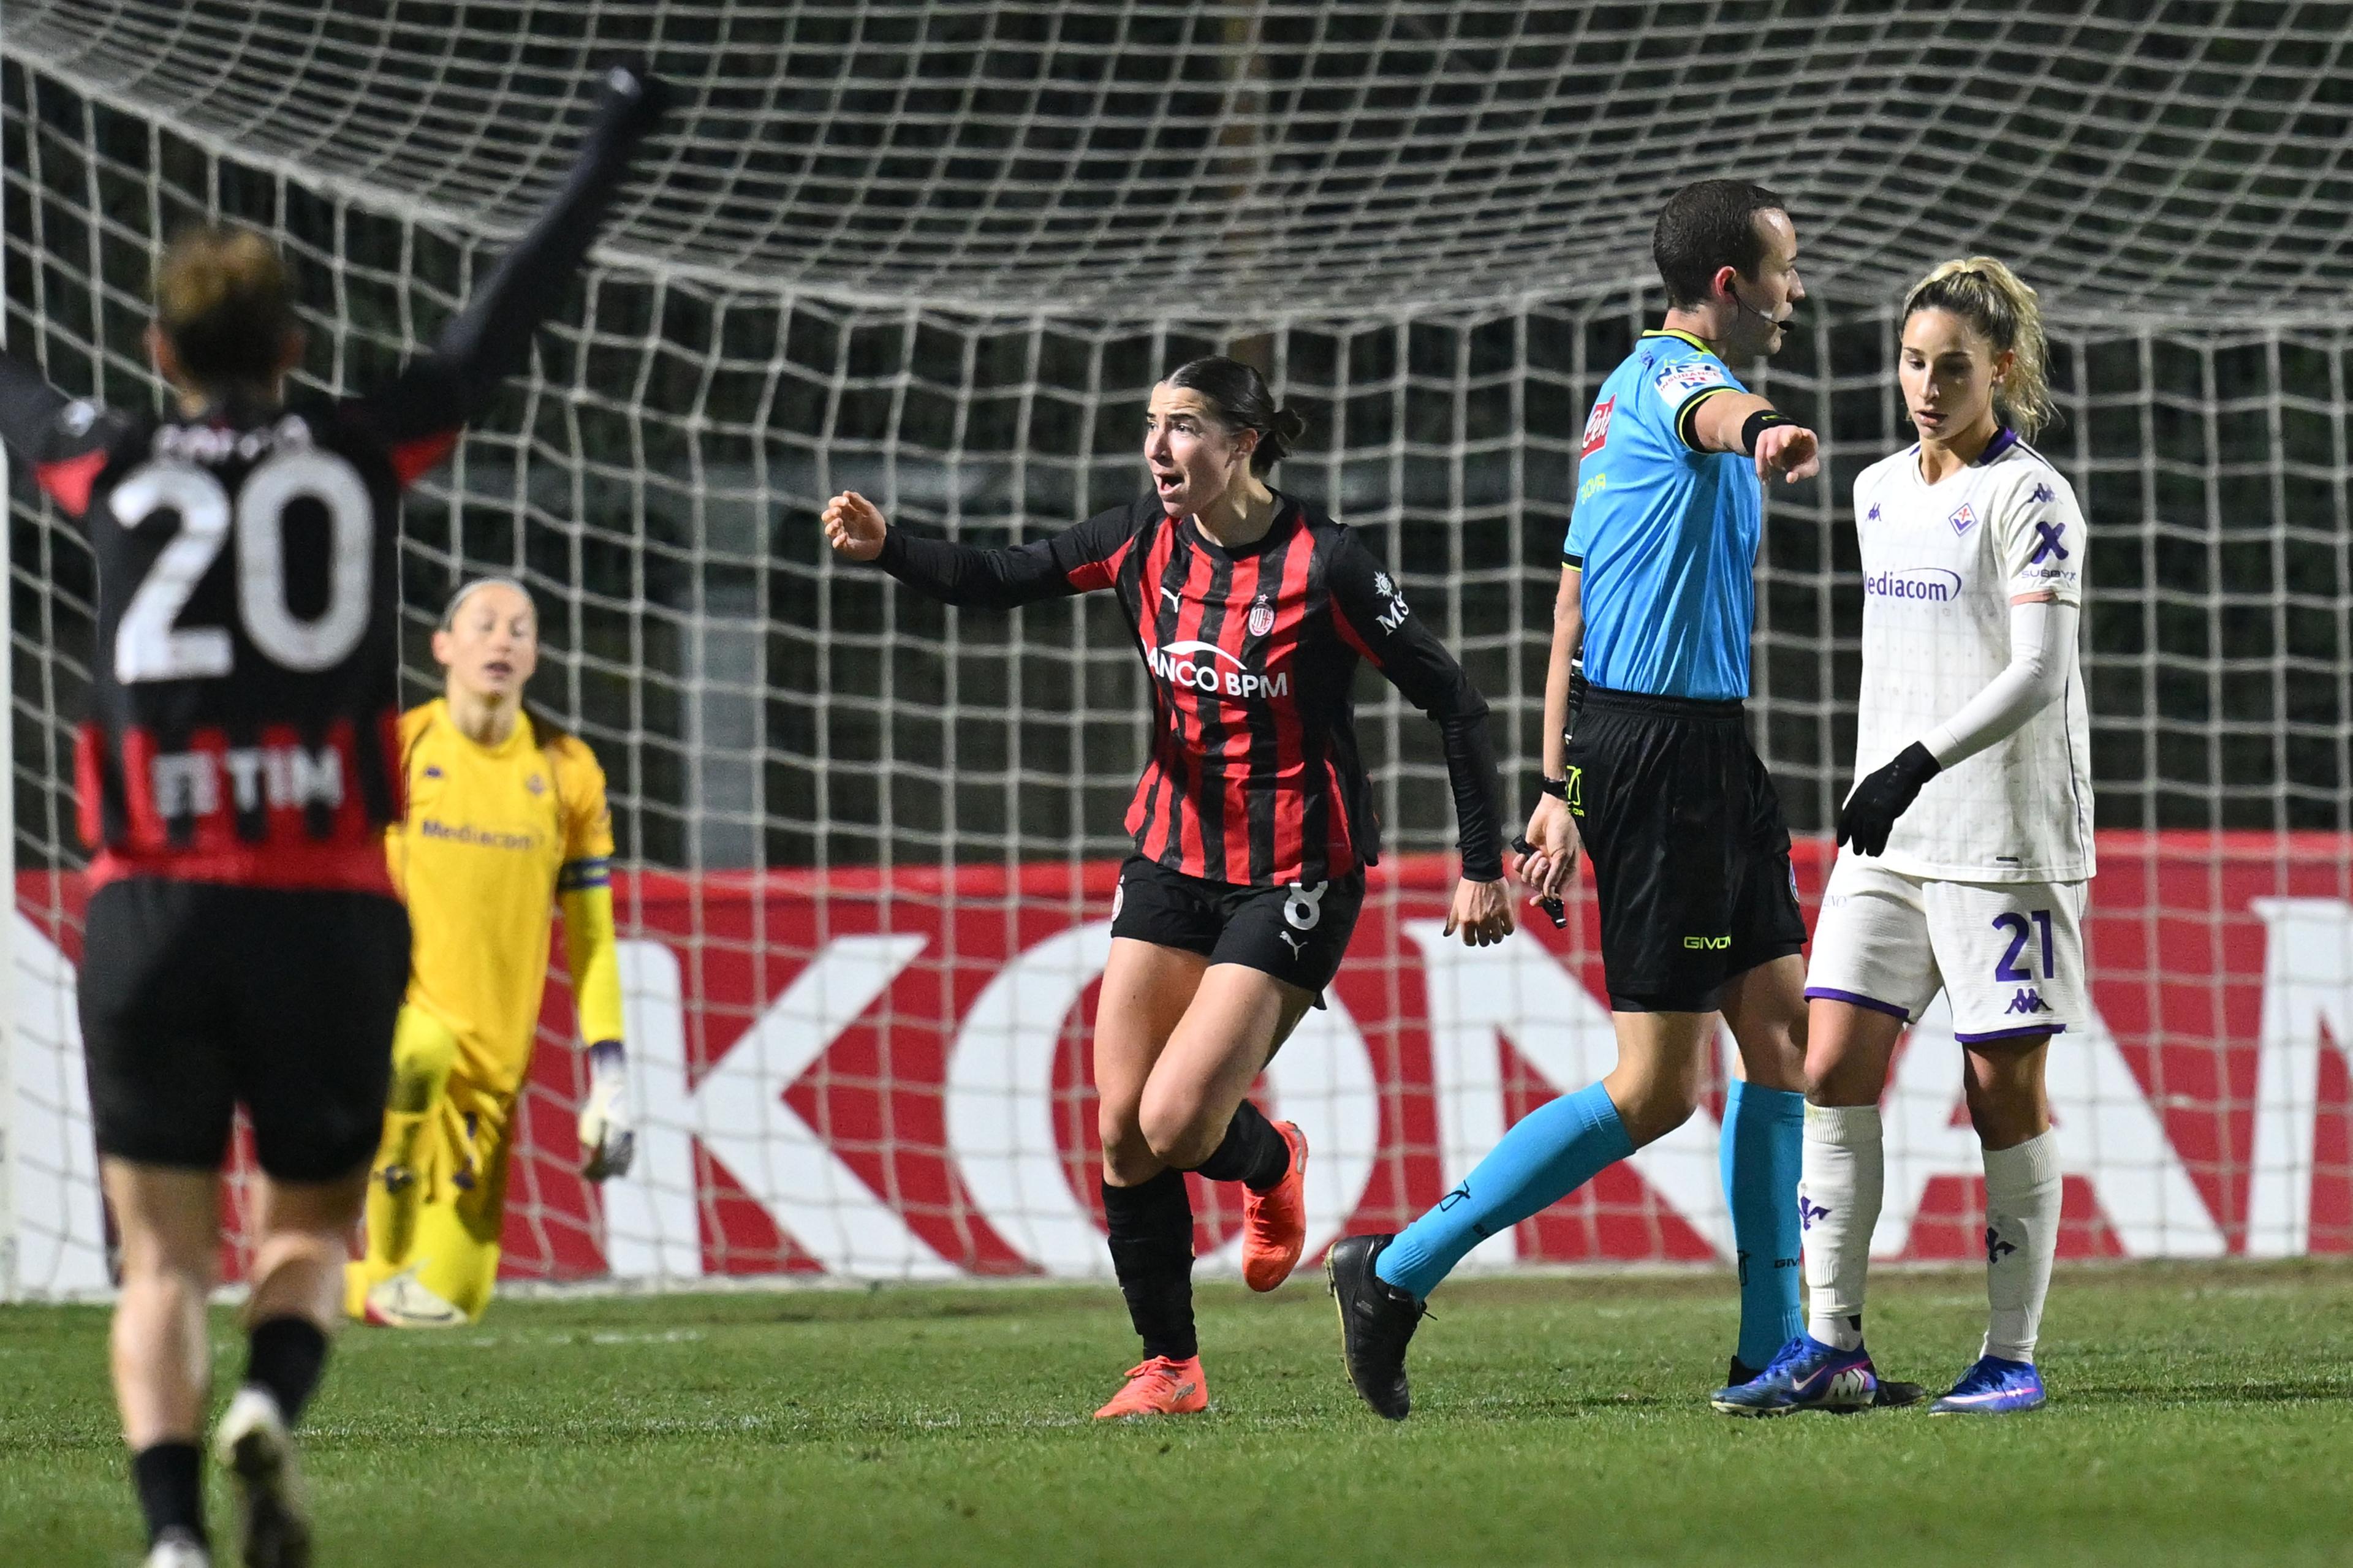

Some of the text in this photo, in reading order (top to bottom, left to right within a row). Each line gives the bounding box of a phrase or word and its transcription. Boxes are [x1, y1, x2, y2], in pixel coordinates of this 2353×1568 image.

[110, 451, 376, 684] 20
[1864, 570, 1948, 602] ediacom
[1225, 672, 1287, 699] BPM
[1991, 909, 2055, 982] 21
